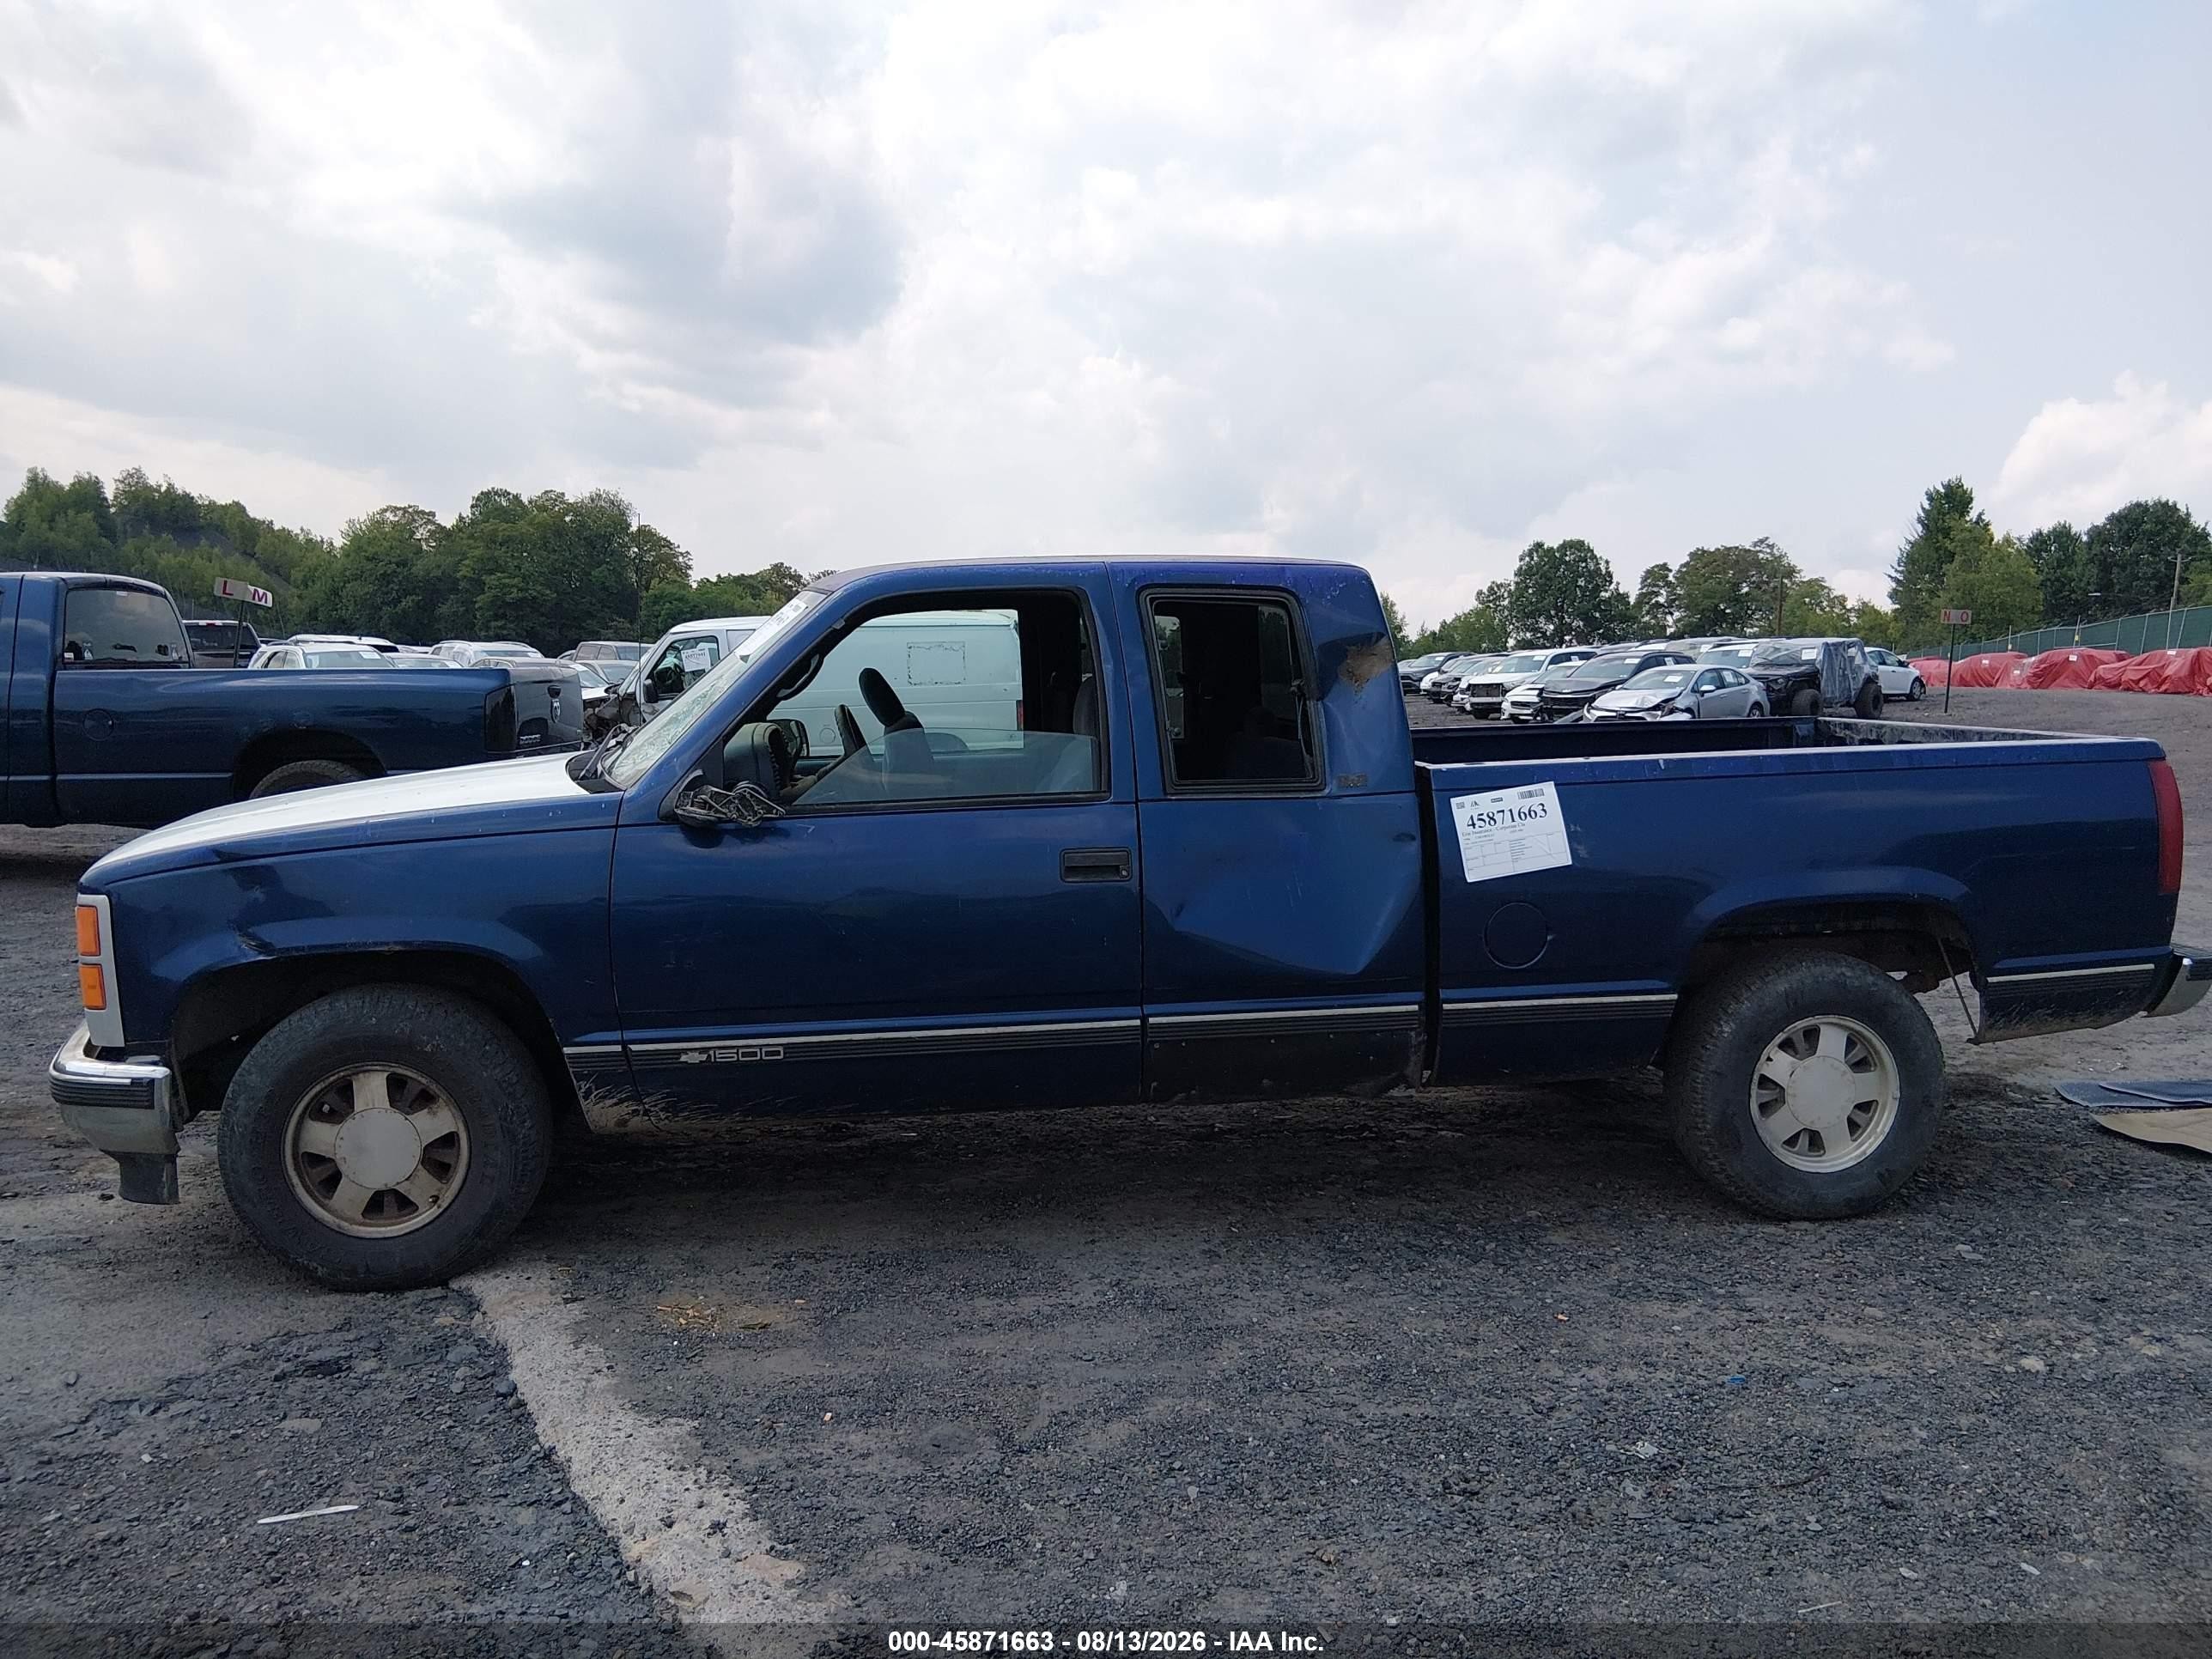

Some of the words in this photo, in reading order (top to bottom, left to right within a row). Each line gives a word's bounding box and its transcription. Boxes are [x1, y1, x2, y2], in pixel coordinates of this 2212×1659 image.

[222, 580, 234, 596] L
[252, 588, 268, 604] M
[1943, 611, 1951, 623] N
[1467, 802, 1547, 830] 45871663
[709, 1047, 784, 1062] 1500
